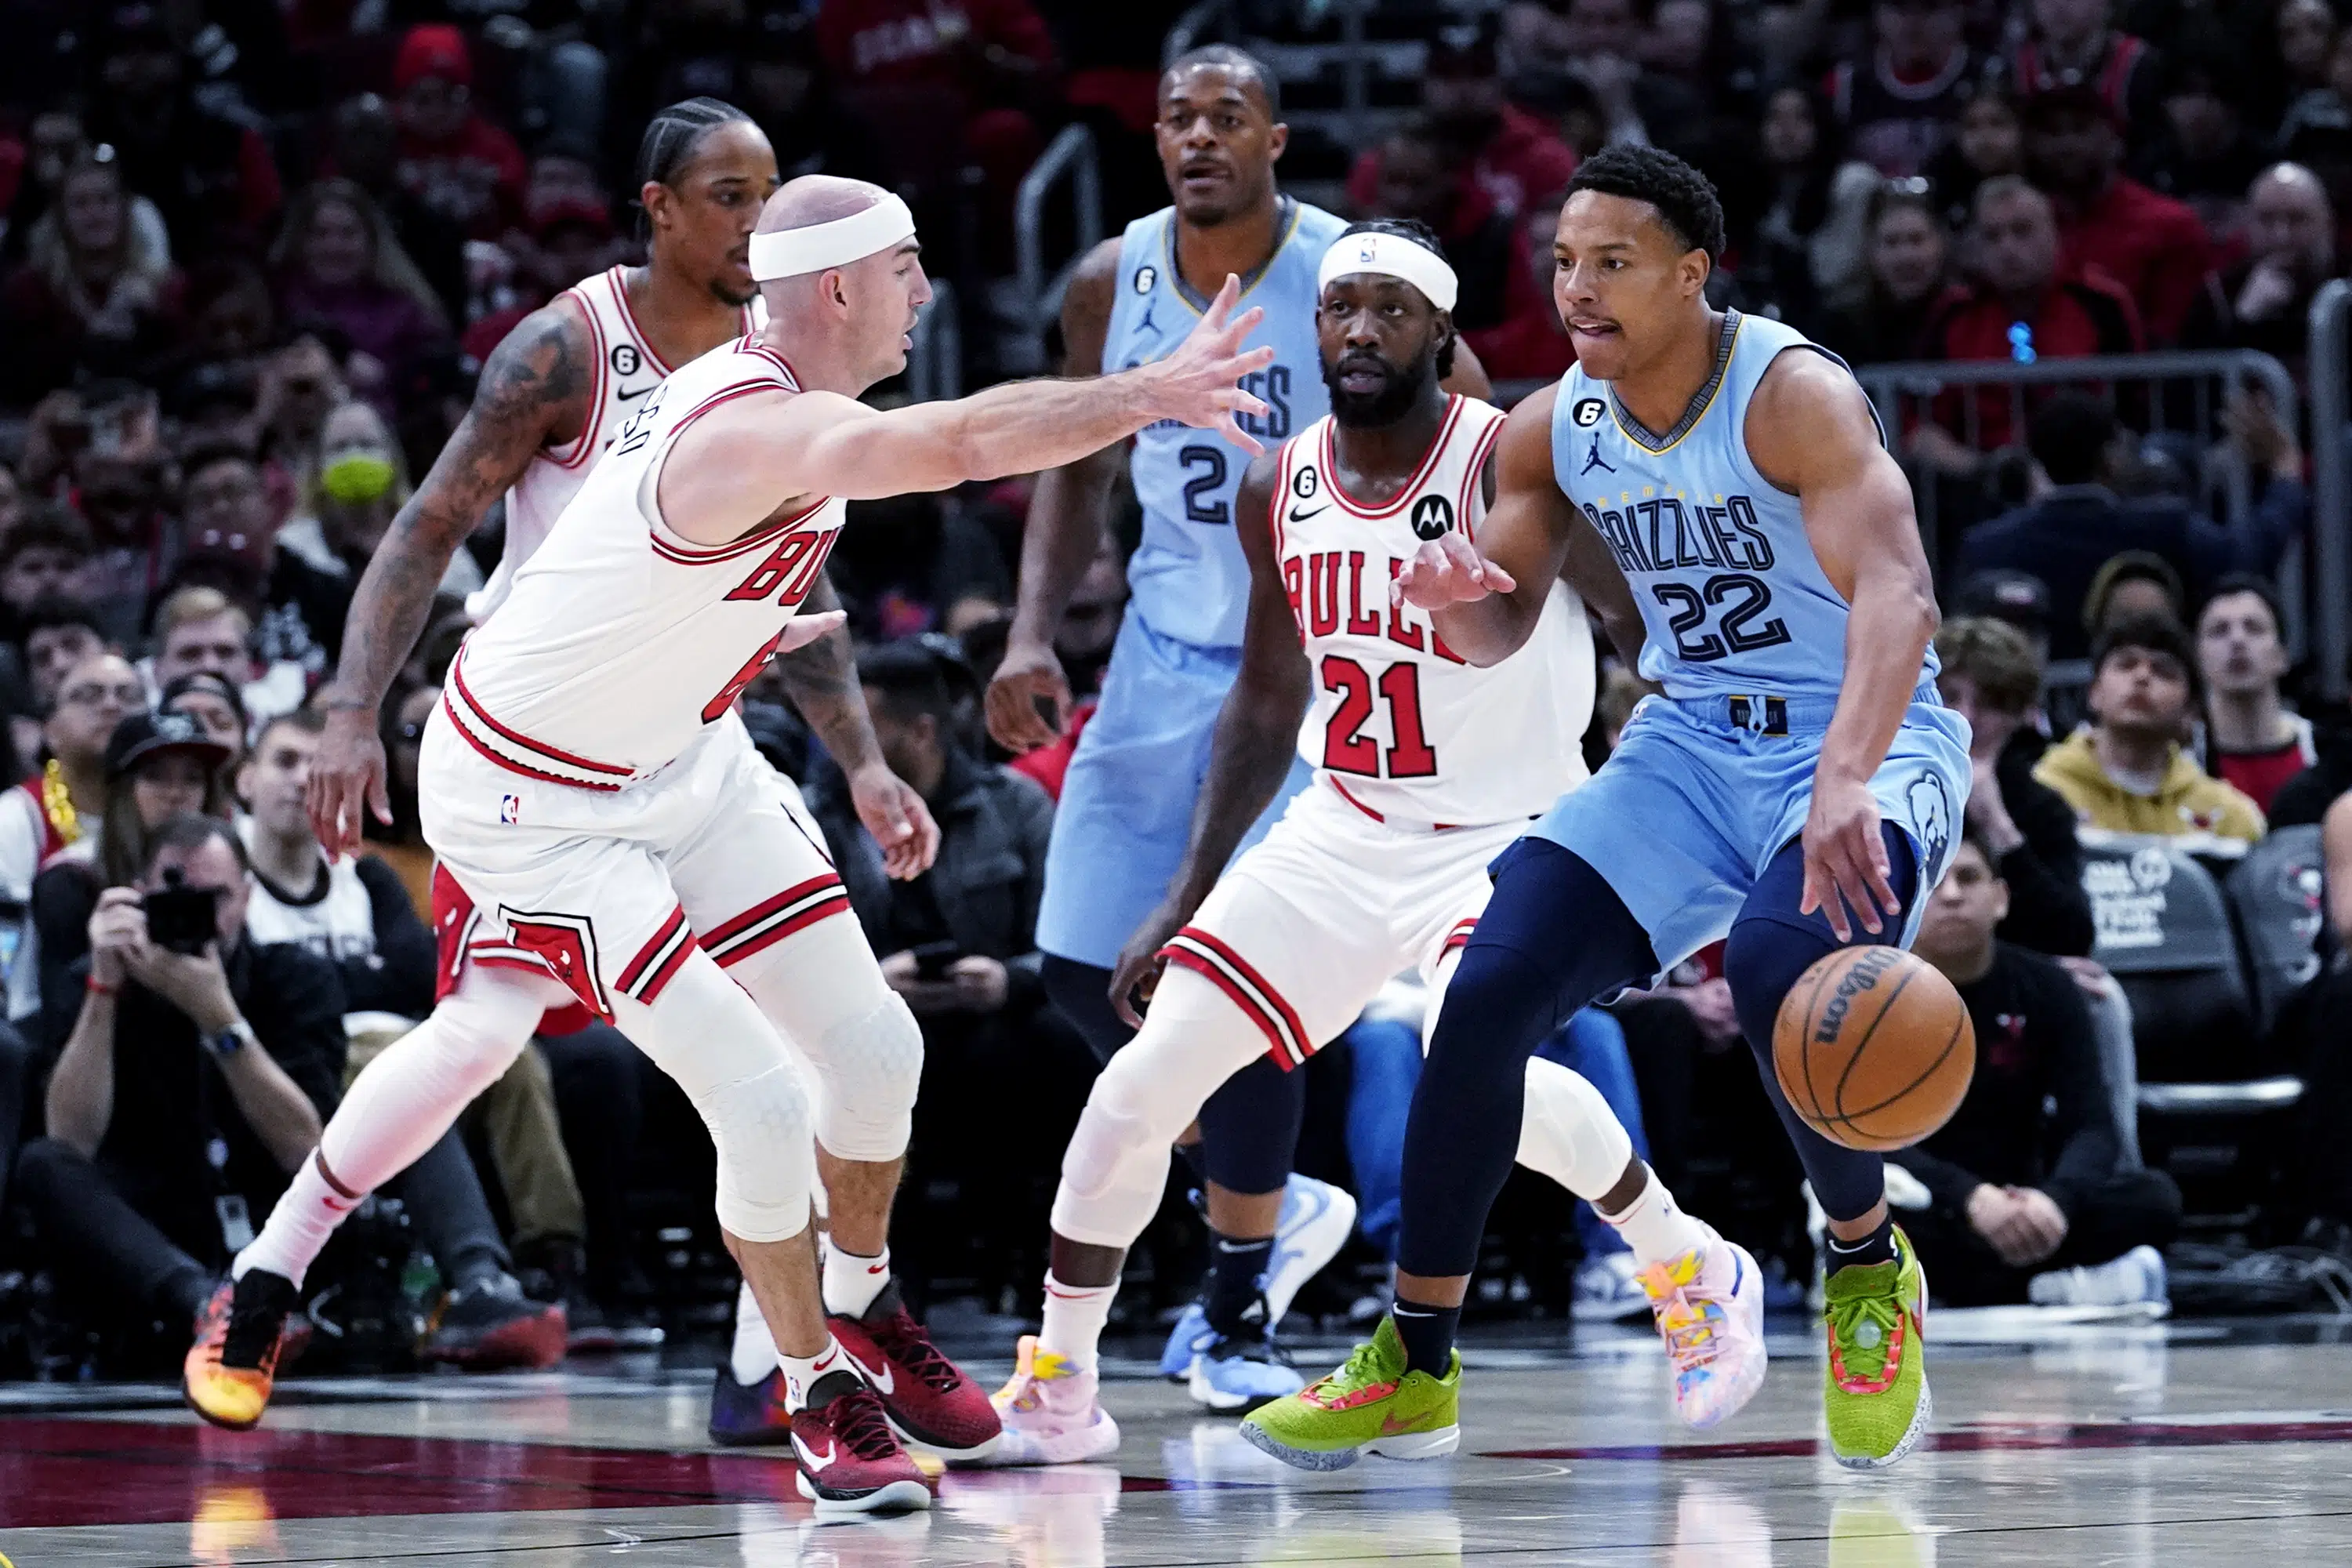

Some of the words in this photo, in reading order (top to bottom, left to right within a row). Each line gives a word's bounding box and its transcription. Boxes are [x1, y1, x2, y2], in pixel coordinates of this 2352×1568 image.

[1134, 267, 1155, 296] 6
[615, 346, 635, 374] 6
[1578, 401, 1602, 424] 6
[1179, 445, 1229, 524] 2
[1298, 467, 1316, 497] 6
[1651, 573, 1792, 662] 22
[1320, 654, 1438, 779] 21
